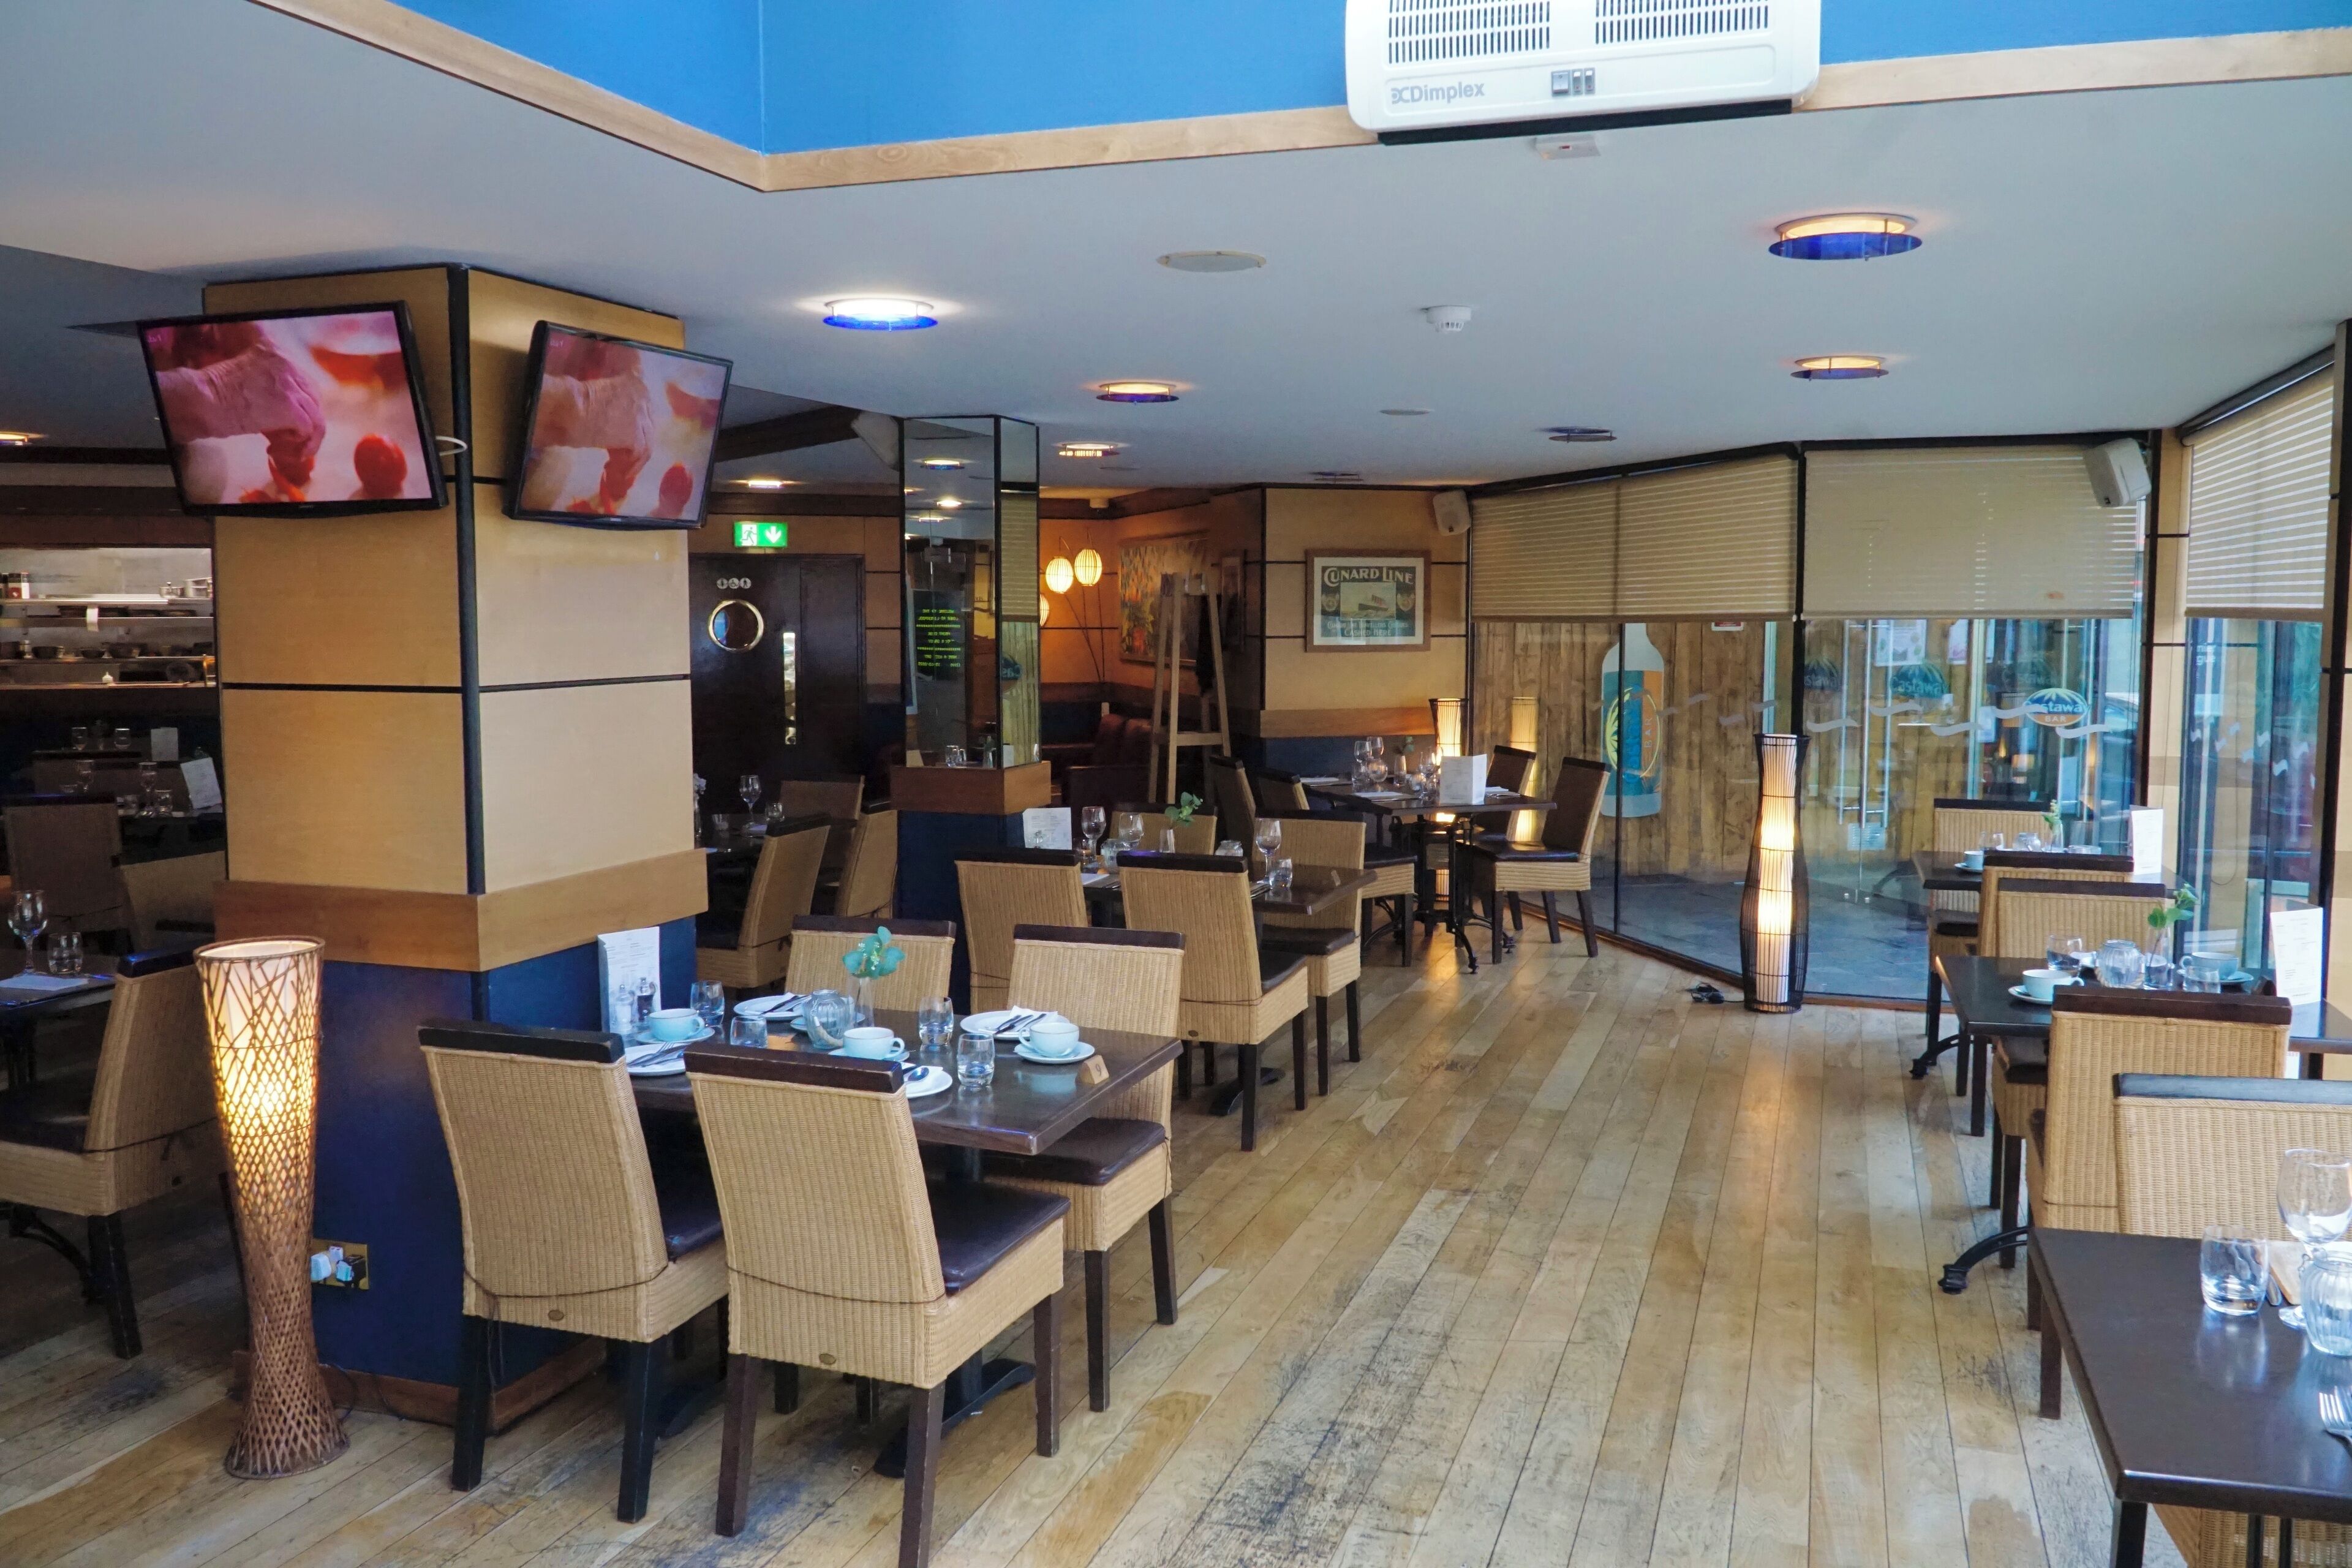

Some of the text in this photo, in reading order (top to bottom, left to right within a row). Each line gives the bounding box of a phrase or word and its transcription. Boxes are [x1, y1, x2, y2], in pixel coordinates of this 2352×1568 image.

[1410, 81, 1485, 104] Dimplex
[1324, 567, 1414, 587] CUNARD LINE
[2022, 700, 2090, 714] staway
[1644, 718, 1653, 748] BAR
